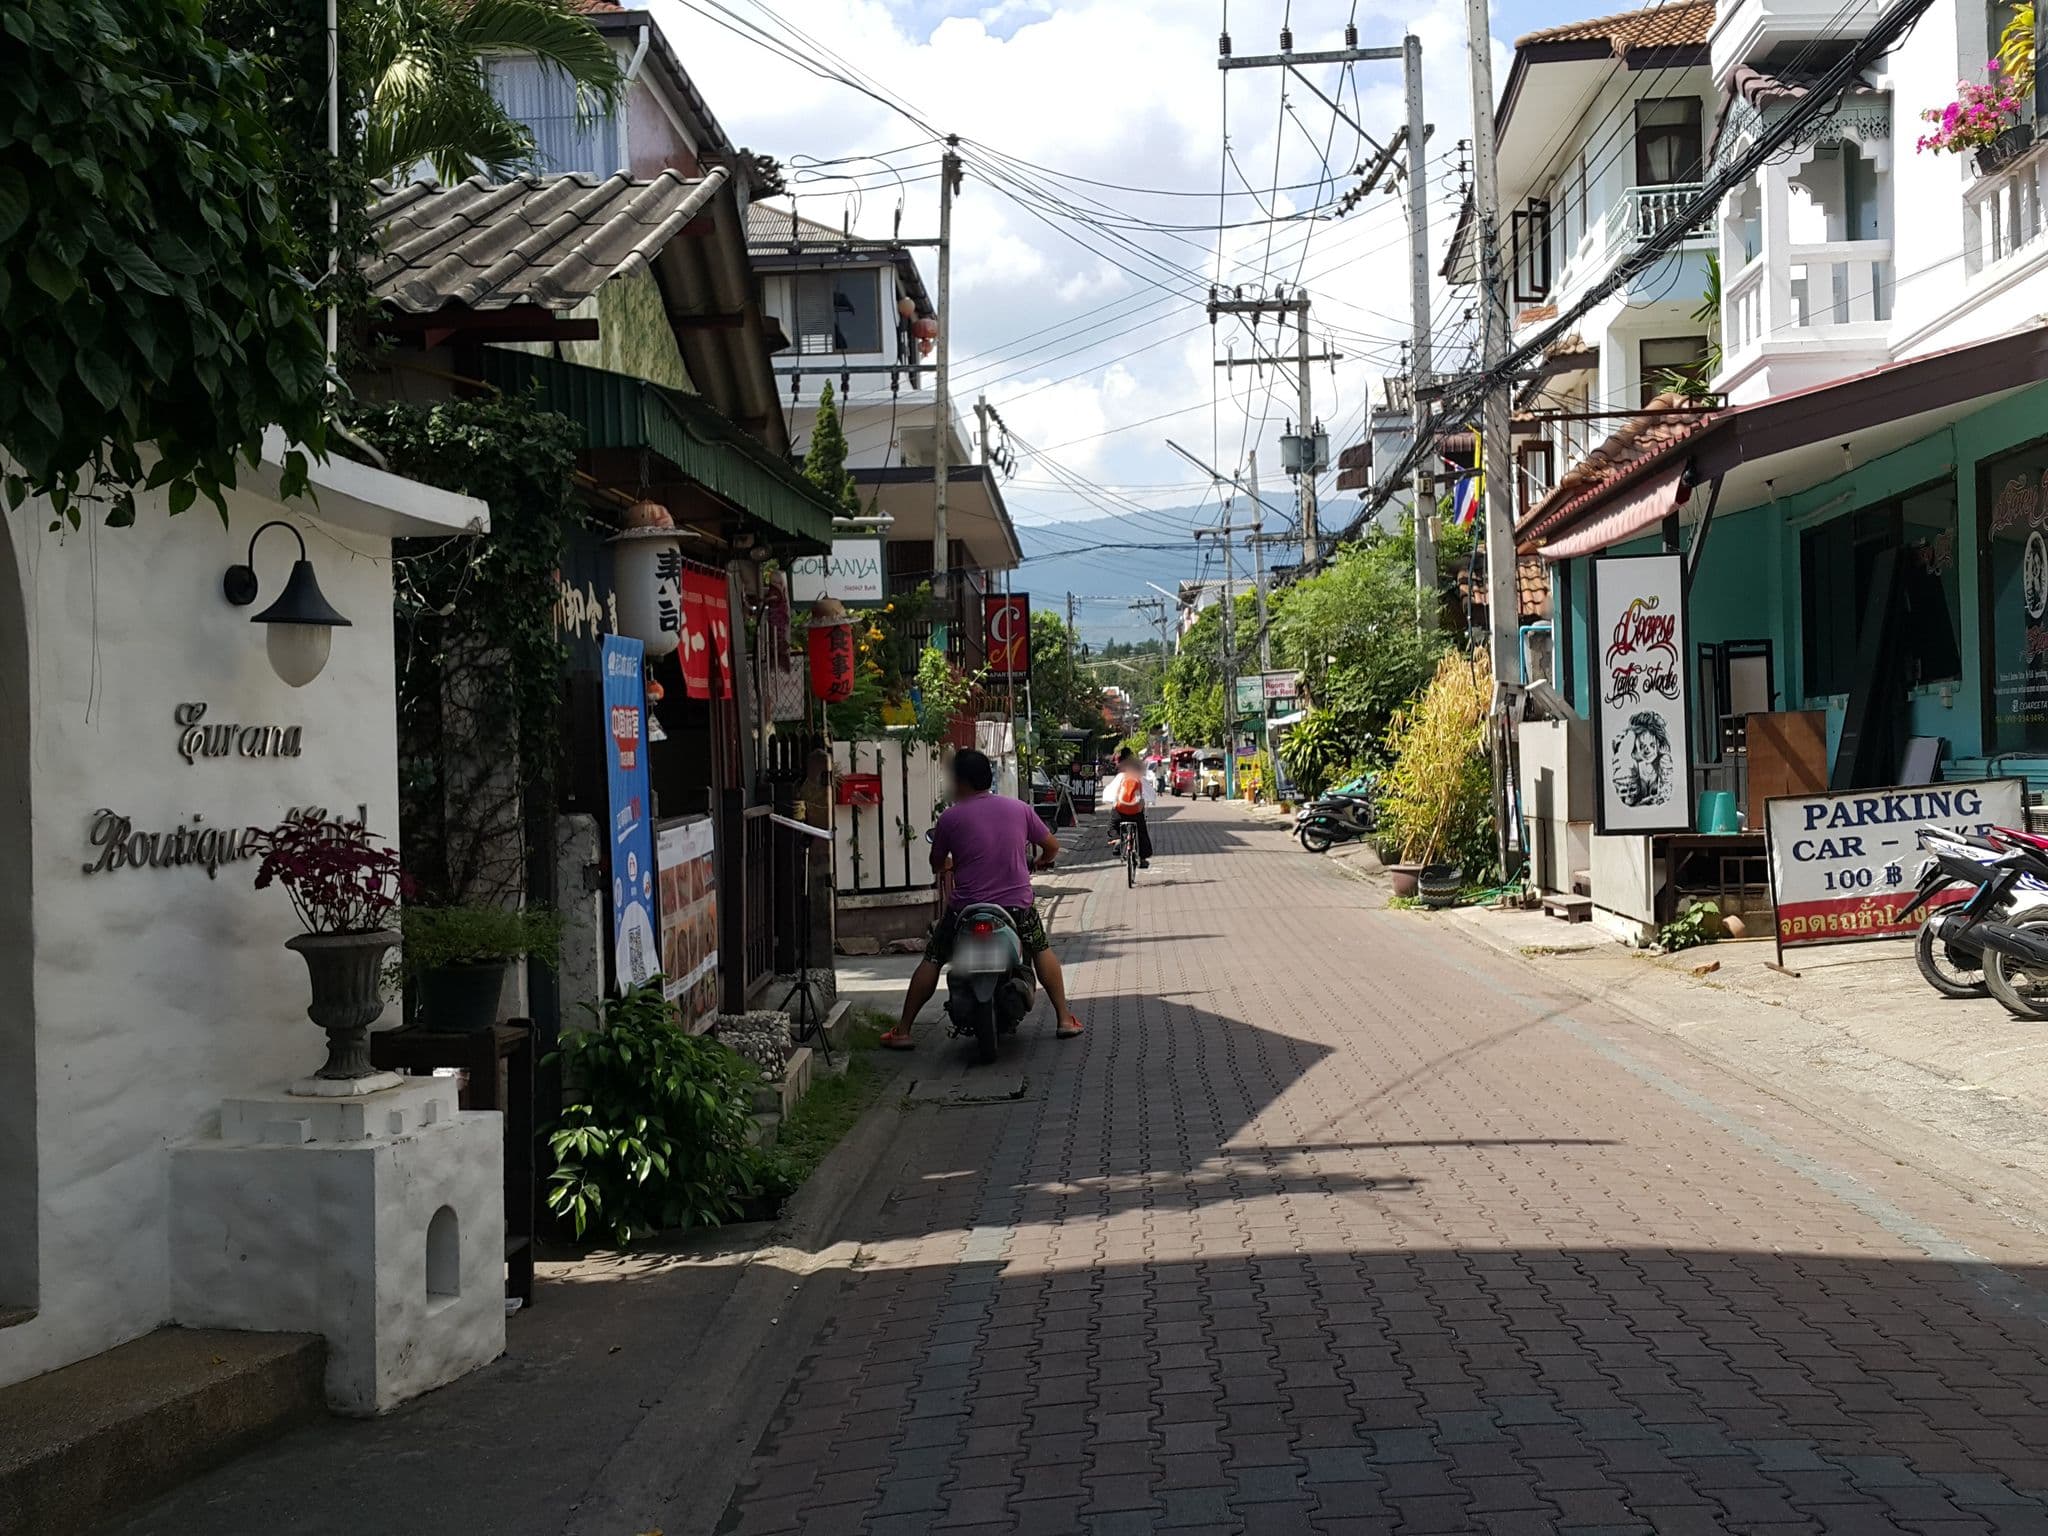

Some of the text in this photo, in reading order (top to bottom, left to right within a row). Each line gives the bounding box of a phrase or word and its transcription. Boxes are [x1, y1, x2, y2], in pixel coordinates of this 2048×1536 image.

[991, 606, 1020, 642] C
[174, 702, 303, 765] Eurana
[1803, 789, 1983, 831] PARKING
[1793, 836, 1866, 862] CAR
[1824, 869, 1873, 891] 100
